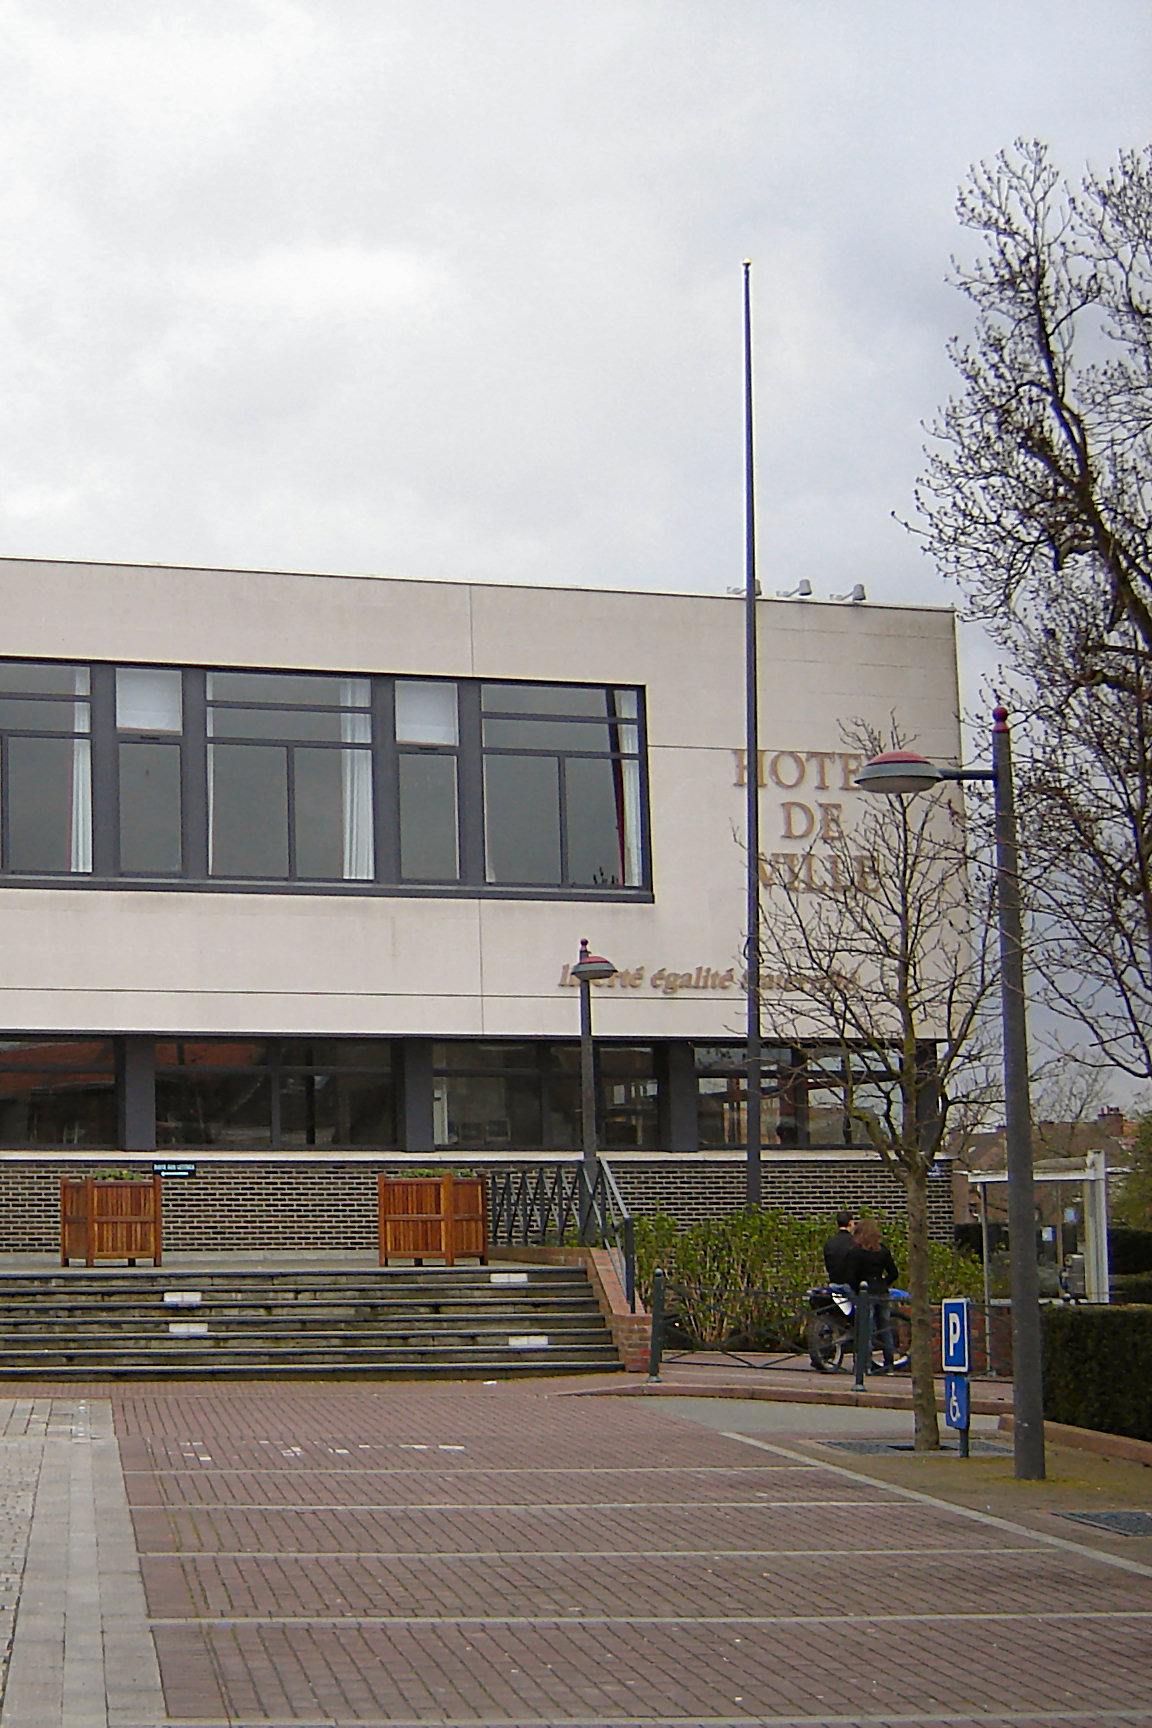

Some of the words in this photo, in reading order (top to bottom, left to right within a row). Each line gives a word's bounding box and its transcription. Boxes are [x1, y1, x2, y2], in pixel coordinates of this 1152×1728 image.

[733, 750, 864, 791] HOTE
[780, 801, 843, 840] DE
[650, 966, 734, 995] égalité
[949, 1312, 961, 1357] P
